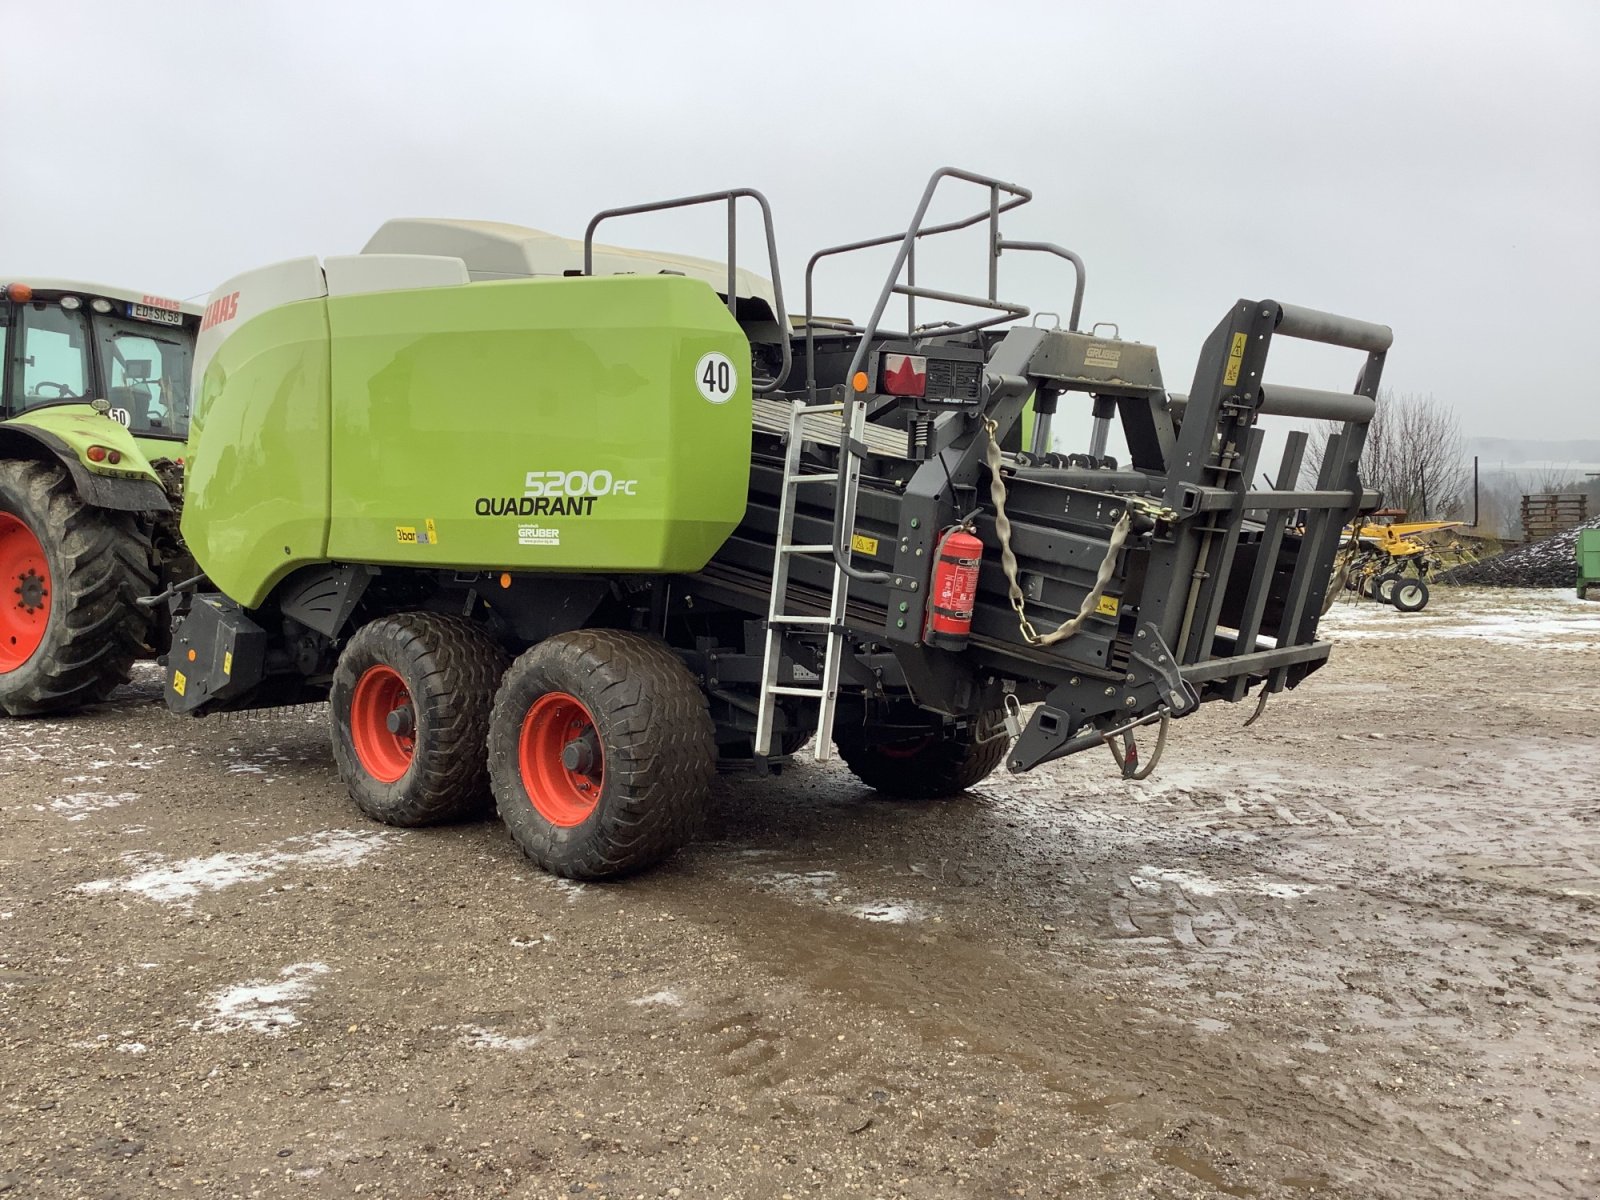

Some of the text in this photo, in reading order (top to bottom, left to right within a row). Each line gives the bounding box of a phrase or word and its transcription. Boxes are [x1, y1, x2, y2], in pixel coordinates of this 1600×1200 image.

[142, 295, 180, 310] CLAAS
[135, 304, 180, 323] ED SR 58
[702, 360, 730, 394] 40
[524, 469, 638, 497] 5200 FC
[475, 496, 598, 516] QUADRANT
[518, 528, 560, 538] GRUBER
